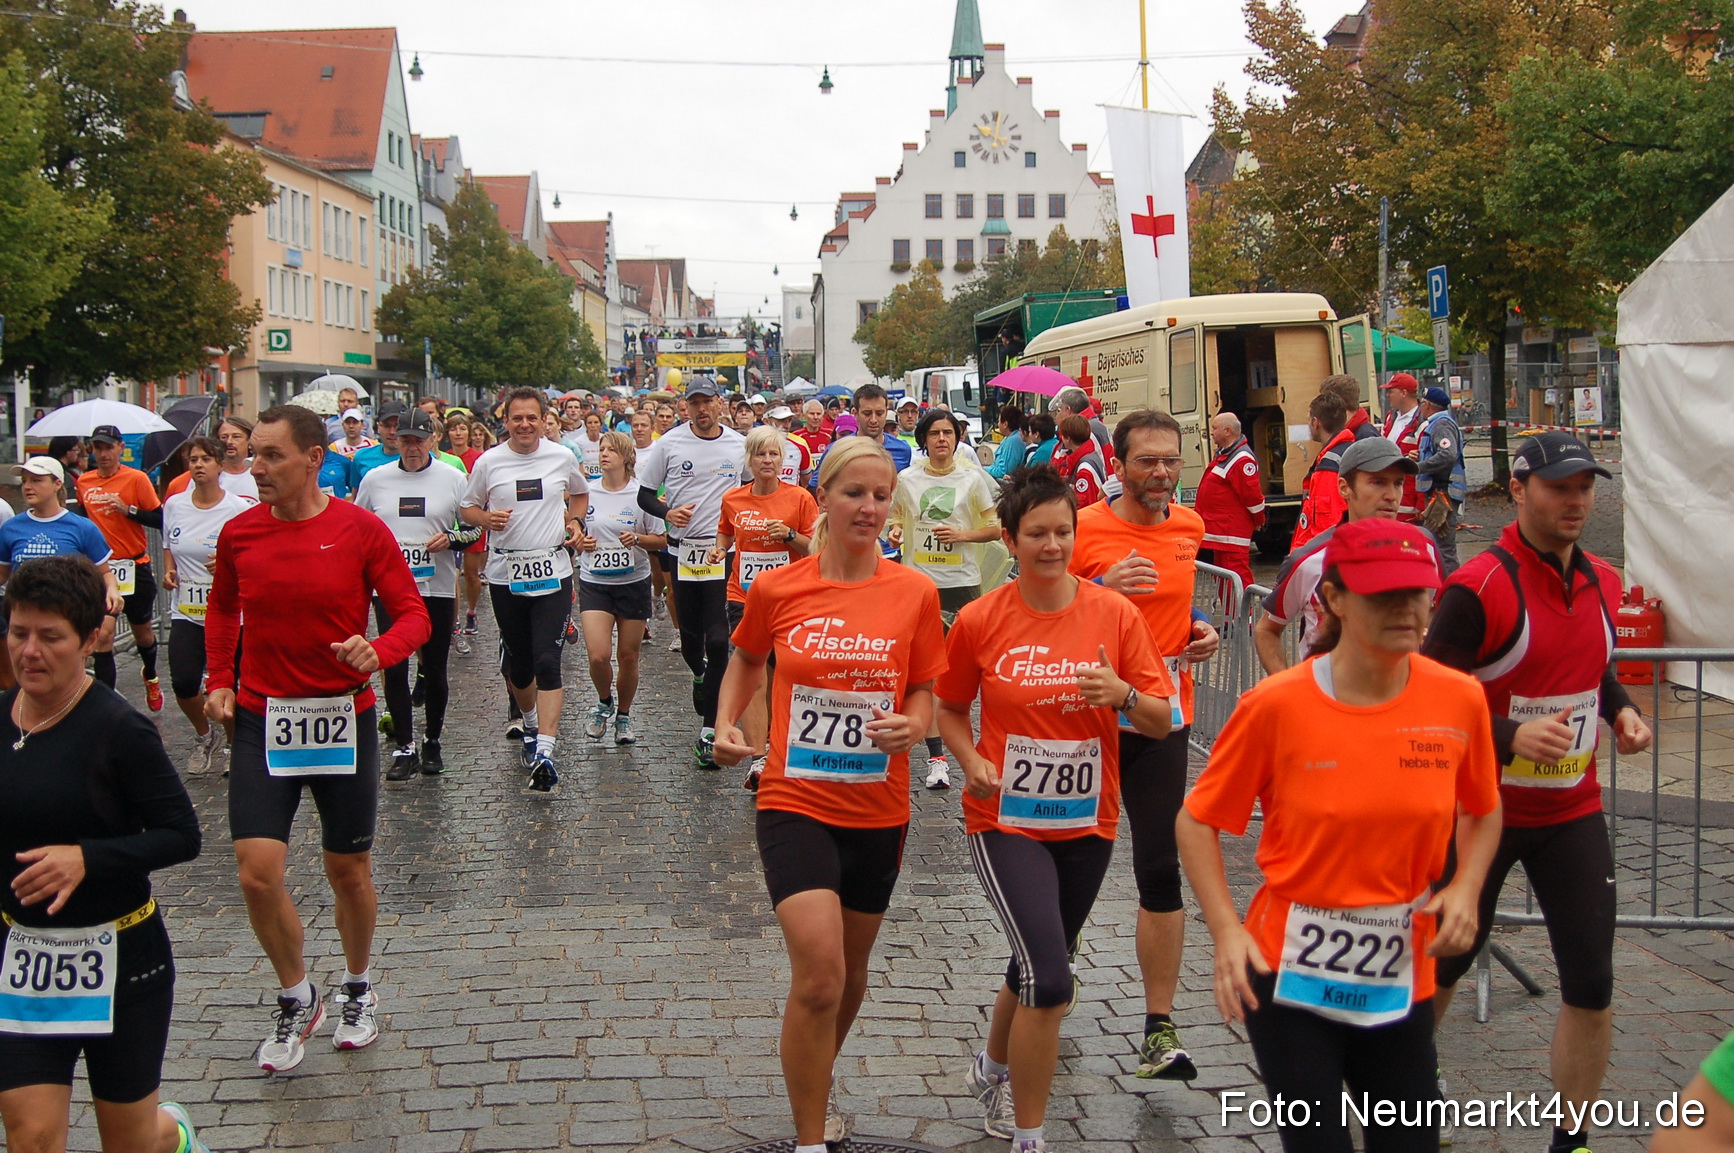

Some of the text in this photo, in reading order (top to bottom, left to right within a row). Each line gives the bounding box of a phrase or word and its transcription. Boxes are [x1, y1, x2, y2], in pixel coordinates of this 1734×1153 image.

[1431, 274, 1442, 312] P
[271, 331, 288, 349] D
[686, 356, 716, 364] START
[1097, 347, 1144, 373] Bayerisches
[1097, 375, 1119, 394] Rotes
[594, 552, 630, 568] 2393
[687, 550, 707, 565] 47
[512, 560, 553, 580] 2488
[691, 567, 711, 575] Henrik
[524, 582, 546, 591] Martin
[804, 632, 896, 651] Fischer
[811, 651, 888, 661] AUTOMOBILE
[827, 670, 847, 679] und
[850, 667, 868, 678] das
[1020, 676, 1085, 687] AUTOMOB
[793, 693, 826, 706] PARTL
[1036, 694, 1055, 705] und
[1057, 691, 1076, 702] das
[268, 704, 341, 714] PARTL Neumarkt
[1511, 705, 1547, 715] PARTL
[275, 715, 348, 746] 3102
[799, 709, 878, 748] 278
[1007, 743, 1086, 759] PARTL Neumarkt
[1407, 739, 1444, 753] Team
[812, 754, 863, 770] Kristina
[1399, 756, 1450, 770] heba-tec
[1533, 760, 1579, 775] Konrad
[1011, 759, 1094, 795] 2780
[1033, 803, 1067, 816] Anita
[1293, 904, 1399, 928] PARTL Neumarkt
[9, 931, 95, 947] PARTL Neumarkt
[1296, 922, 1405, 979] 2222
[10, 948, 104, 992] 3053
[1322, 984, 1368, 1008] Karin
